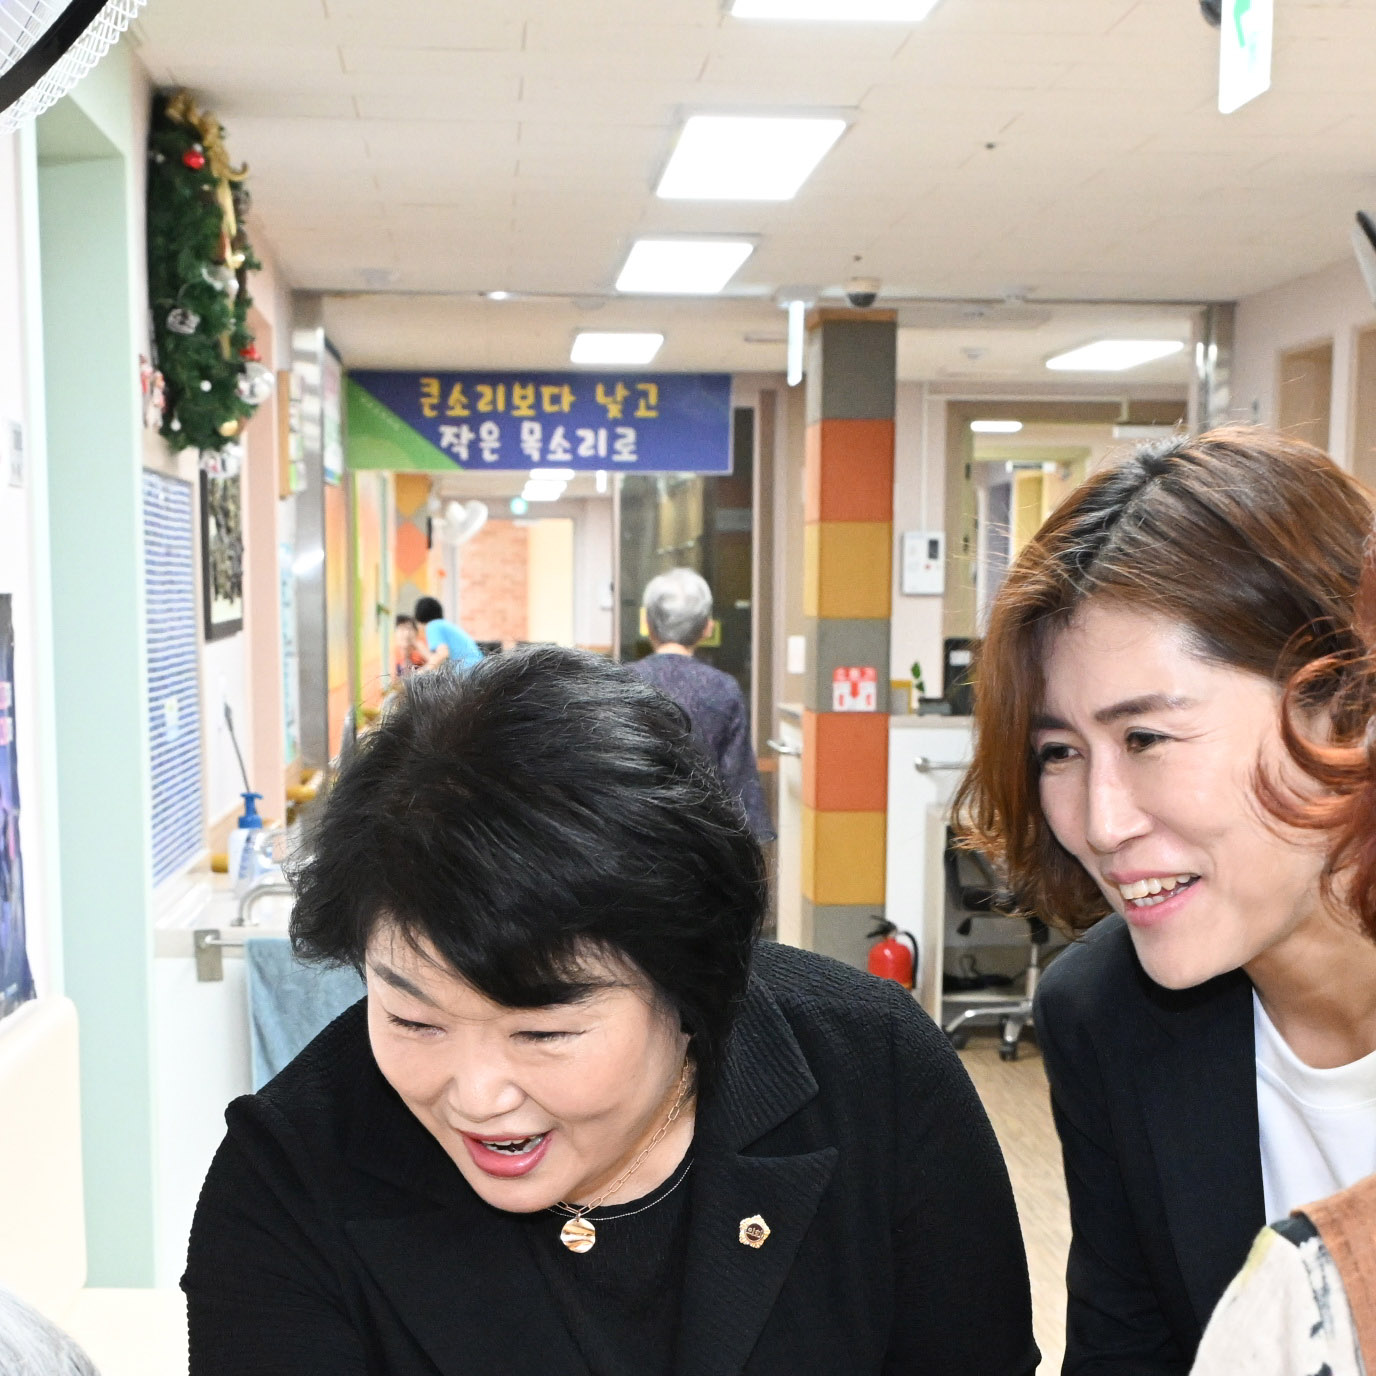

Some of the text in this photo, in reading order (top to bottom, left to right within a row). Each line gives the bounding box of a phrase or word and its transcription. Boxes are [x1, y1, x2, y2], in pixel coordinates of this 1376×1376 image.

[420, 377, 576, 418] 큰소리보다
[595, 382, 660, 420] 낮고
[439, 420, 639, 463] 작은 목소리로
